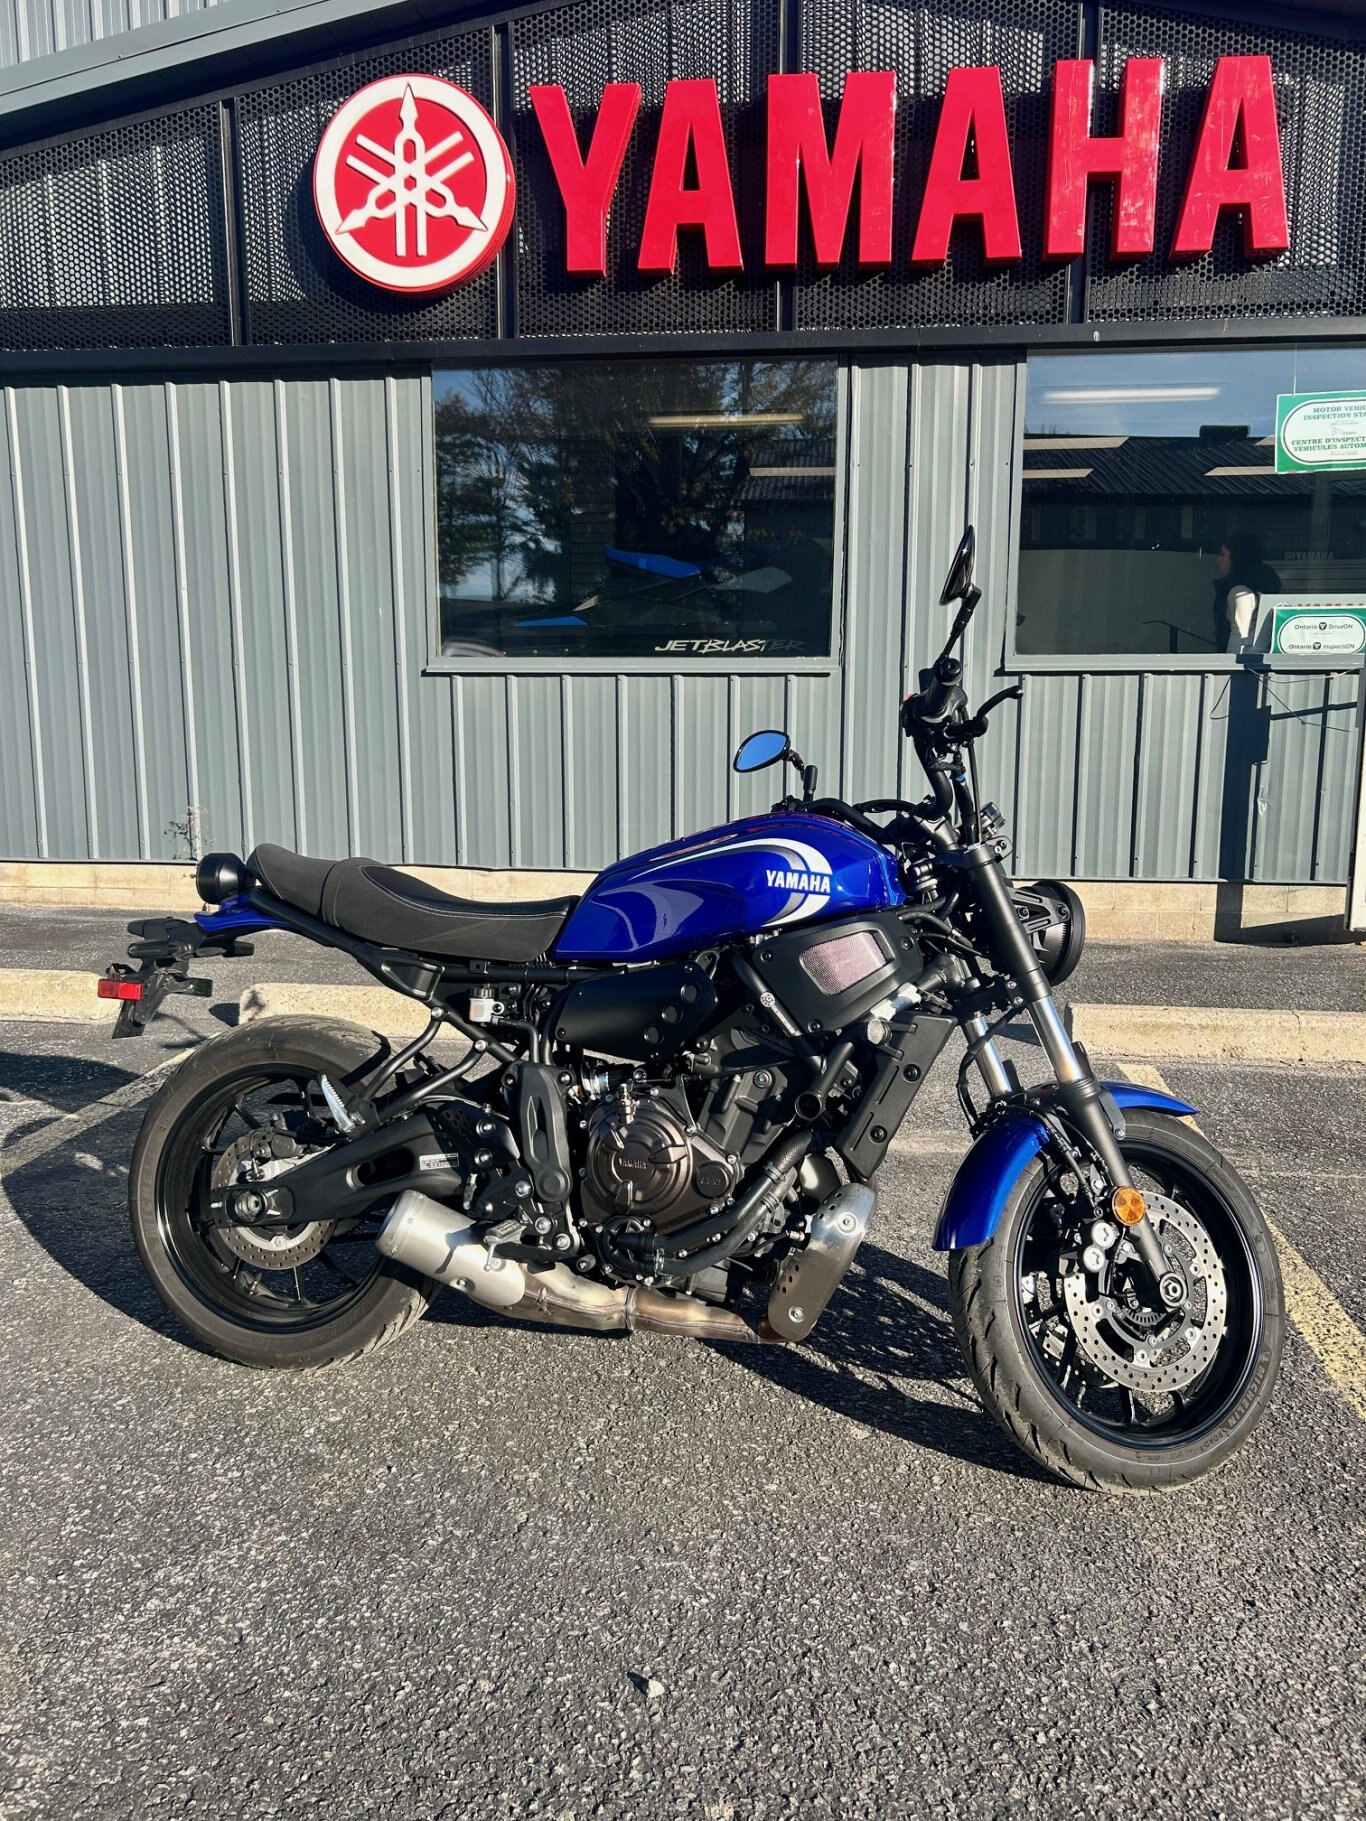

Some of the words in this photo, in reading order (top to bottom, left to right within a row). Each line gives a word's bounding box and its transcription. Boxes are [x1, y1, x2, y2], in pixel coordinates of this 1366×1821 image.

[528, 55, 1290, 276] YAMAHA
[1291, 438, 1324, 446] CENTRE
[655, 639, 805, 654] JETBLASTER
[766, 869, 831, 894] YAMAHA
[618, 1157, 648, 1170] YAMAHA
[1228, 1365, 1266, 1428] MICHELIN
